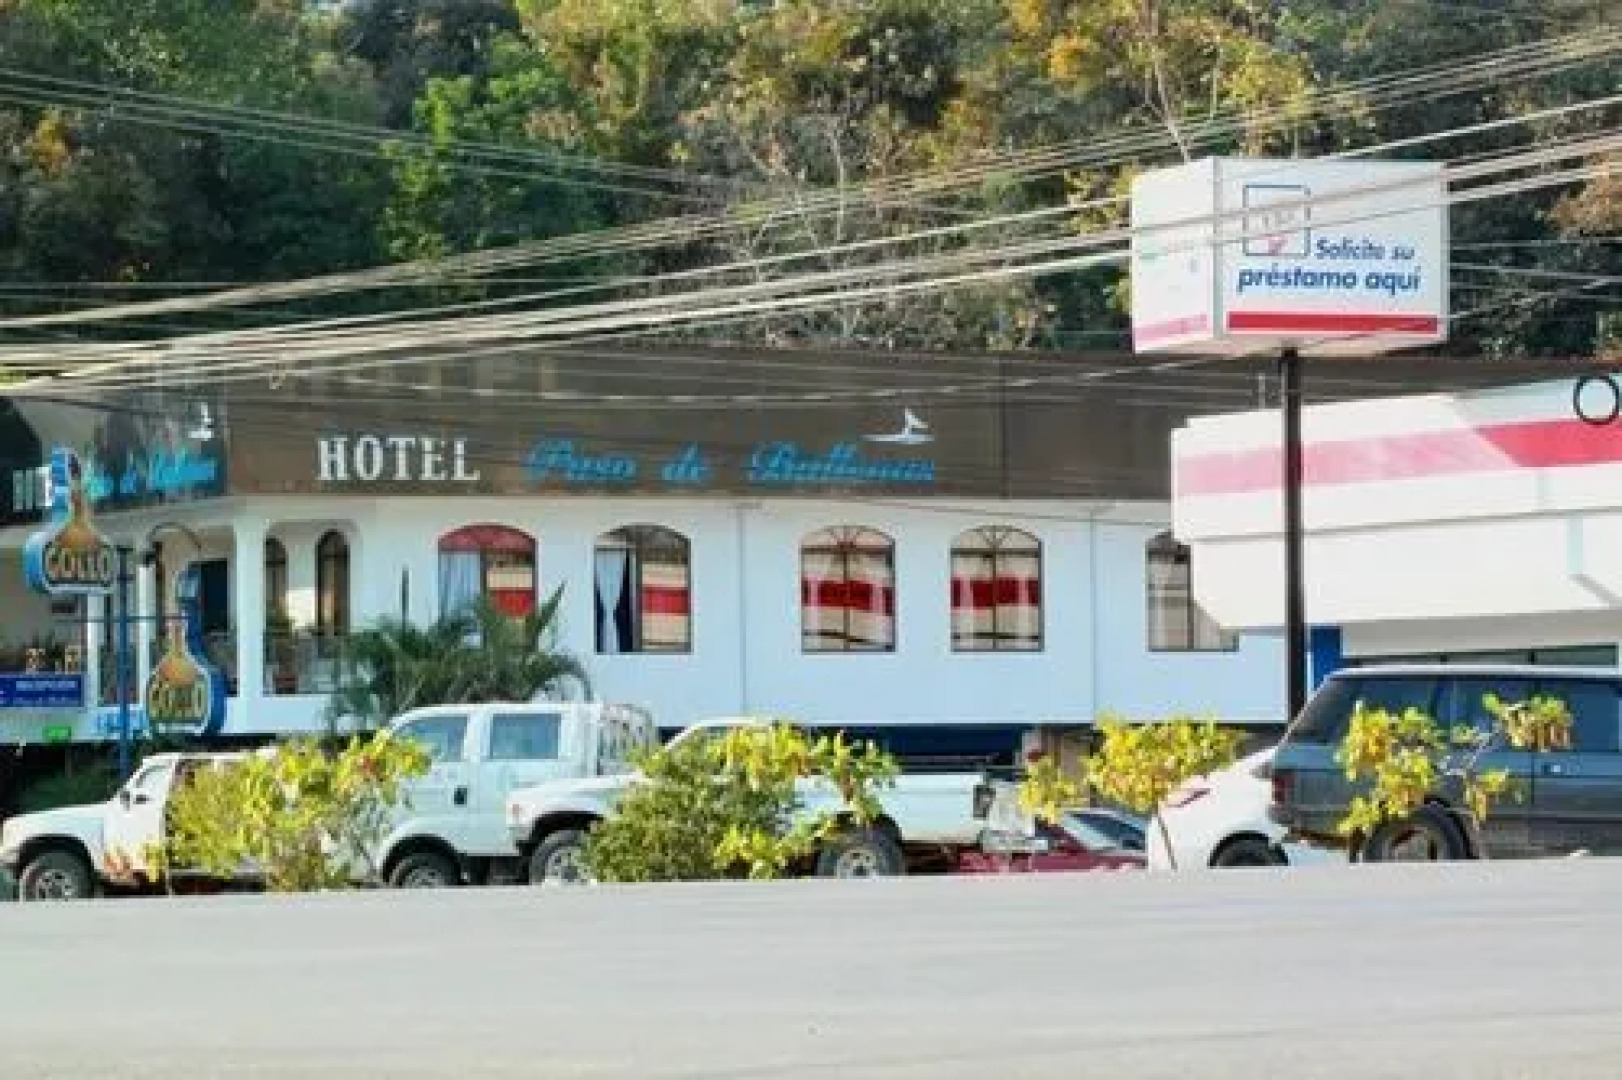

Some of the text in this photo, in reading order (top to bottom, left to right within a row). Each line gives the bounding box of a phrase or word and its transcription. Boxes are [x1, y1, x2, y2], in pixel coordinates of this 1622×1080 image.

[1315, 236, 1415, 261] Solicite su
[1237, 263, 1421, 295] préstamo aquí
[316, 435, 481, 481] HOTEL
